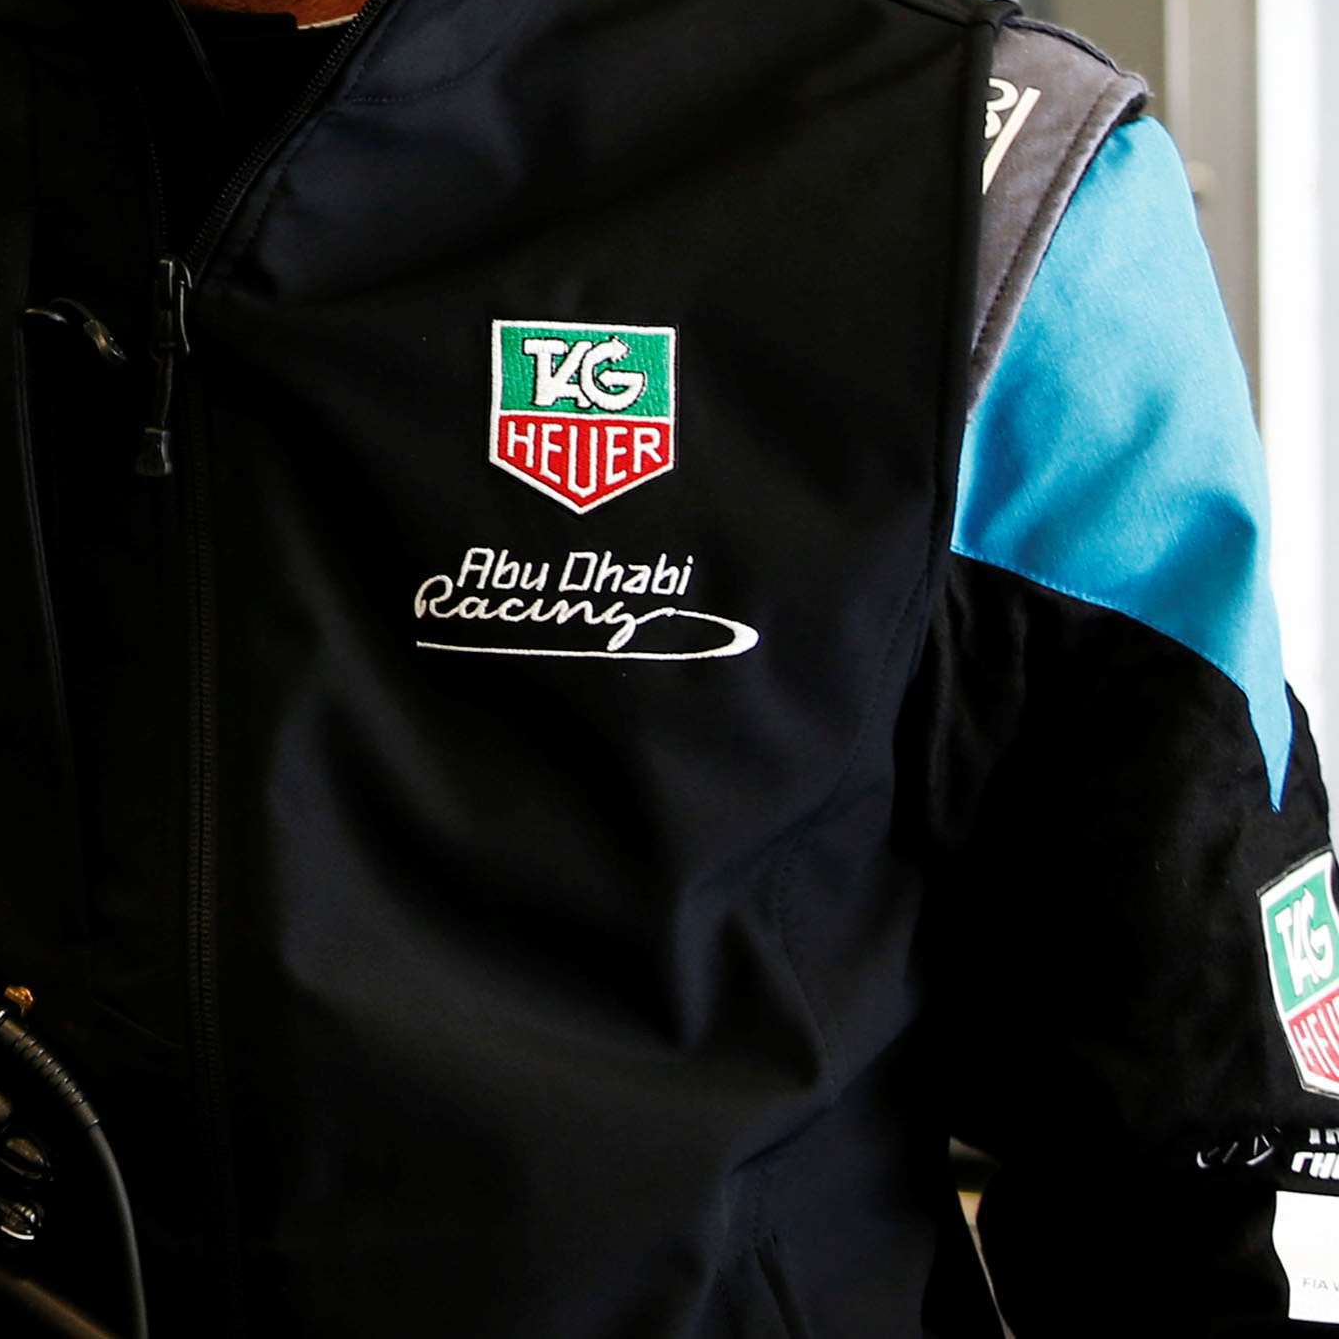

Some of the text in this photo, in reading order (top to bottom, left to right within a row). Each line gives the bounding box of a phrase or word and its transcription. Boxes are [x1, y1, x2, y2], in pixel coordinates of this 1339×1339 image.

[522, 335, 647, 411] TAG
[506, 420, 662, 498] HEUER
[456, 547, 695, 596] Abu Dhabi
[414, 574, 640, 652] Racing
[1274, 887, 1333, 997] TAG
